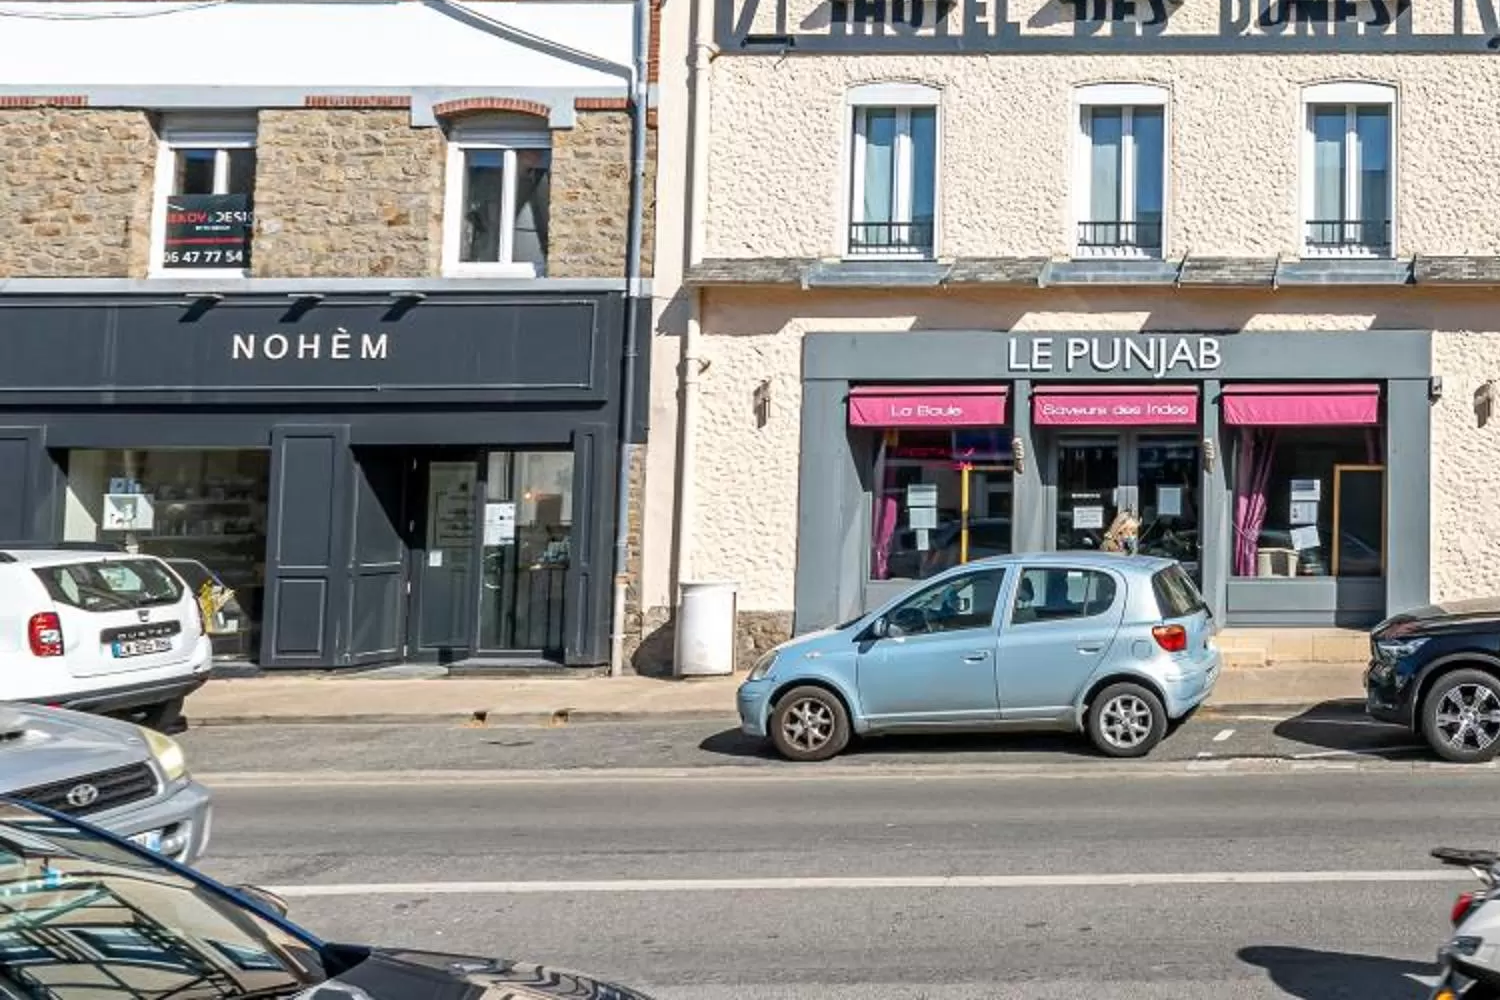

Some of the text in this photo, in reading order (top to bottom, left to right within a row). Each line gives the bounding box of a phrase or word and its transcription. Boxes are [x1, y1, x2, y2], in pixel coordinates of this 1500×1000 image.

[182, 251, 200, 262] 47
[204, 250, 222, 262] 77
[231, 327, 388, 359] NOHÈM
[1007, 337, 1222, 378] LE PUNJAB
